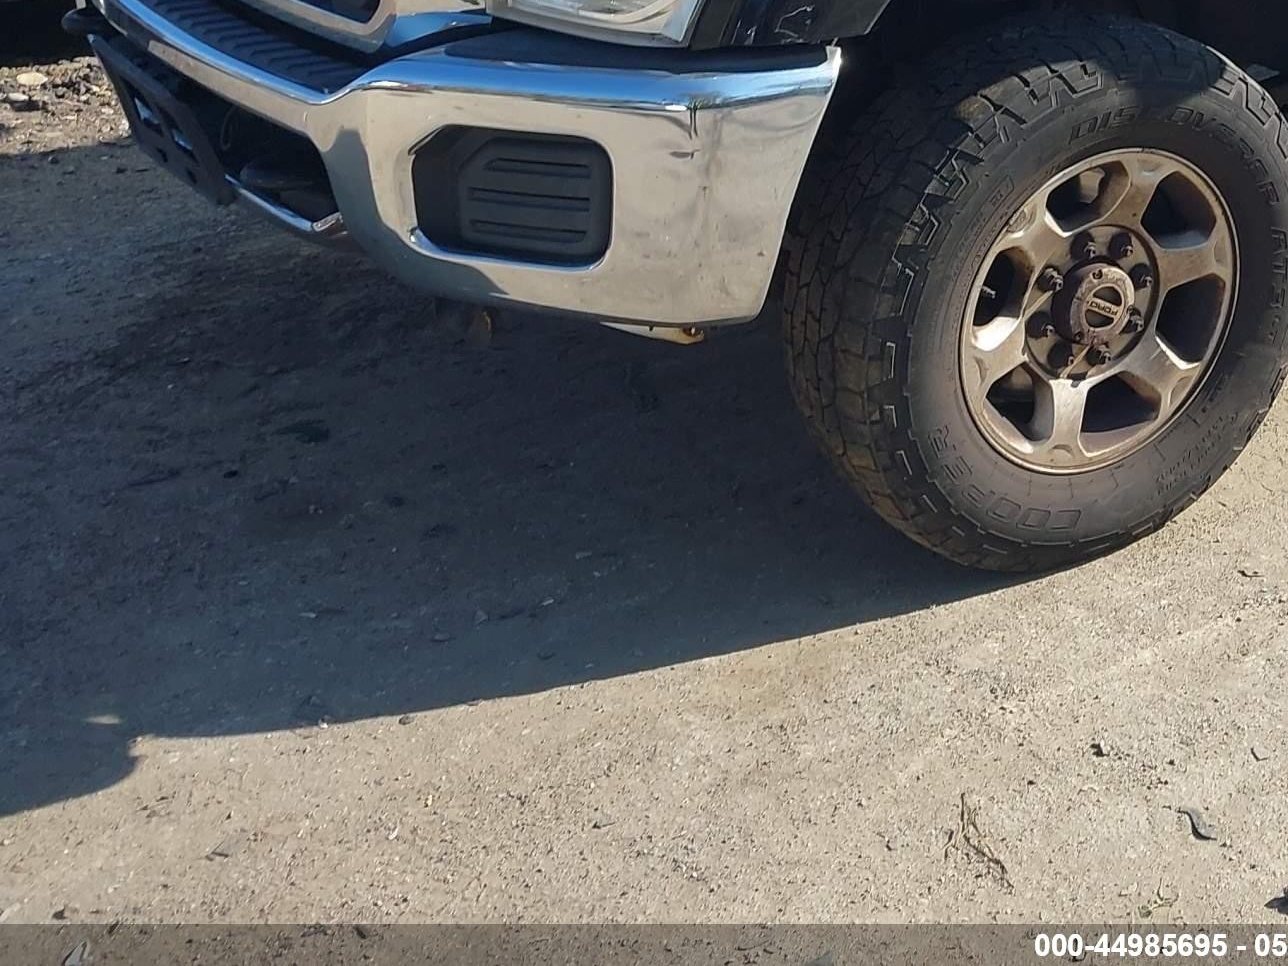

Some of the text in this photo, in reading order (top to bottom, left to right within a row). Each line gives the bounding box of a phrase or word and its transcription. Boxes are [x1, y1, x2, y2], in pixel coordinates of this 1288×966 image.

[1068, 105, 1280, 206] DISOVERER
[1088, 301, 1120, 316] FORD
[928, 425, 1082, 532] COOPER
